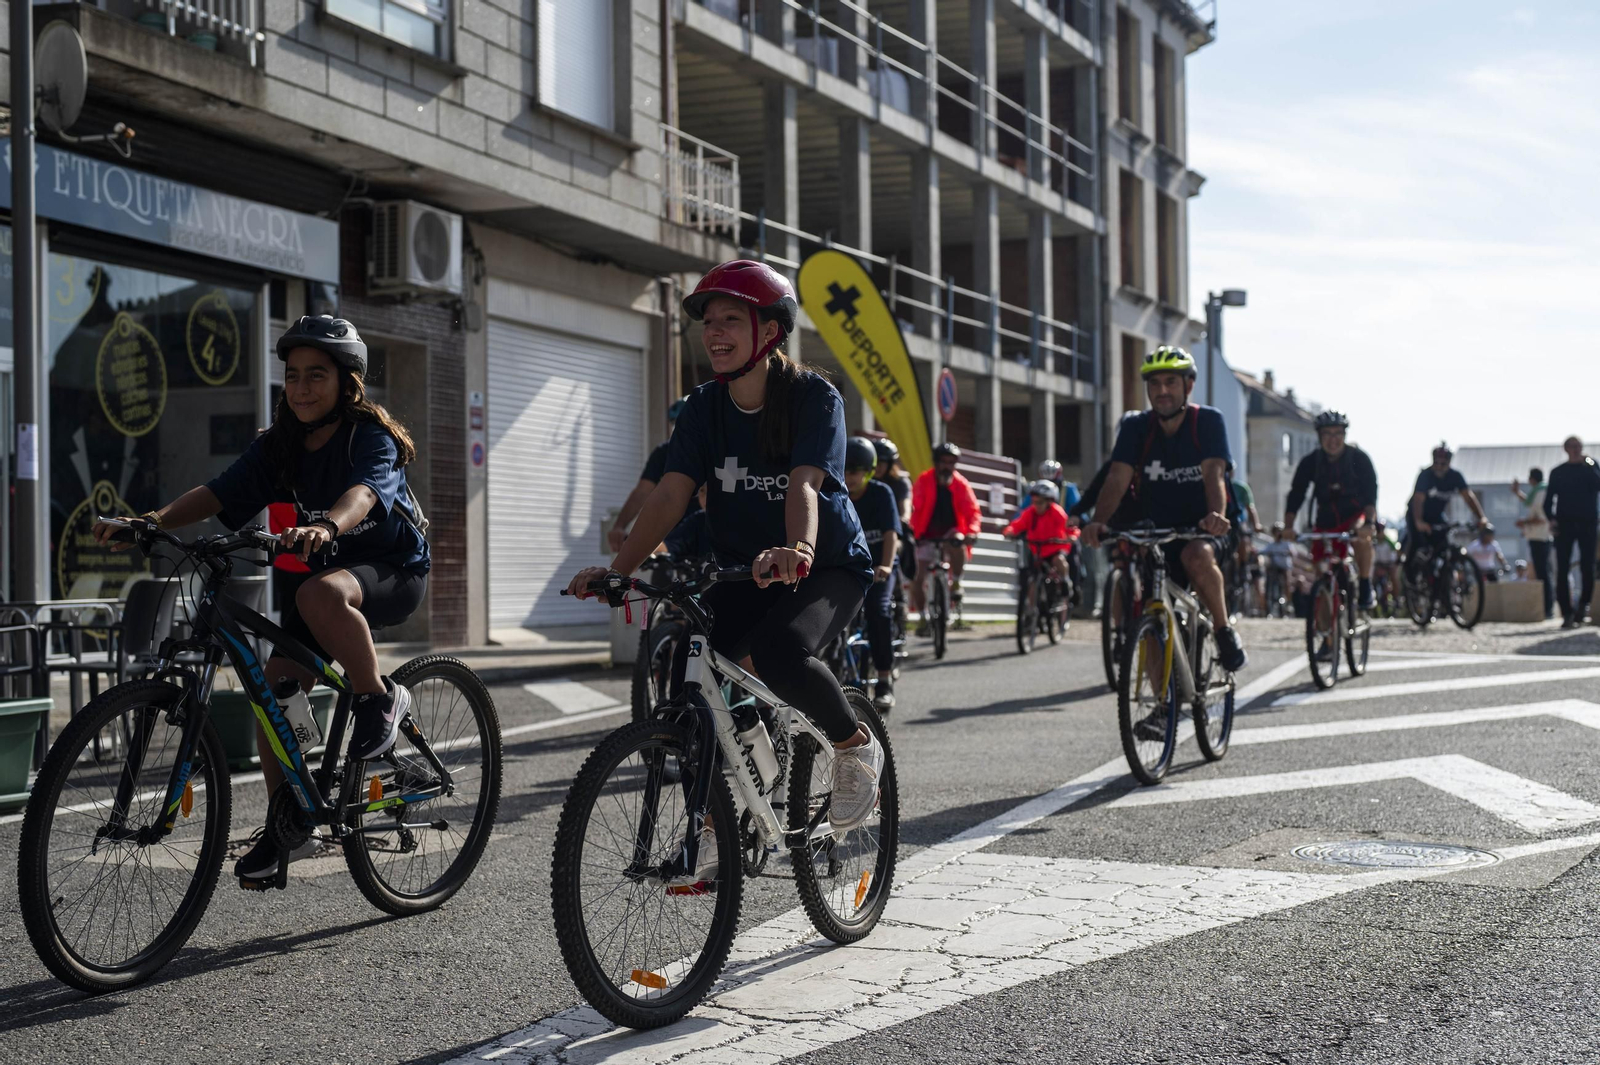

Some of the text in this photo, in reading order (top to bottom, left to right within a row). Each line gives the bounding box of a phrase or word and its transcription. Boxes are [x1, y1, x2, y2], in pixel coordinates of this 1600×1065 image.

[53, 150, 304, 252] ETIQUETA NEGRA
[841, 318, 905, 405] DEPORTE
[849, 350, 863, 370] La
[743, 474, 790, 491] DEPO
[766, 491, 784, 501] La
[344, 519, 378, 536] egión
[295, 727, 309, 744] 500
[176, 761, 192, 787] MTB
